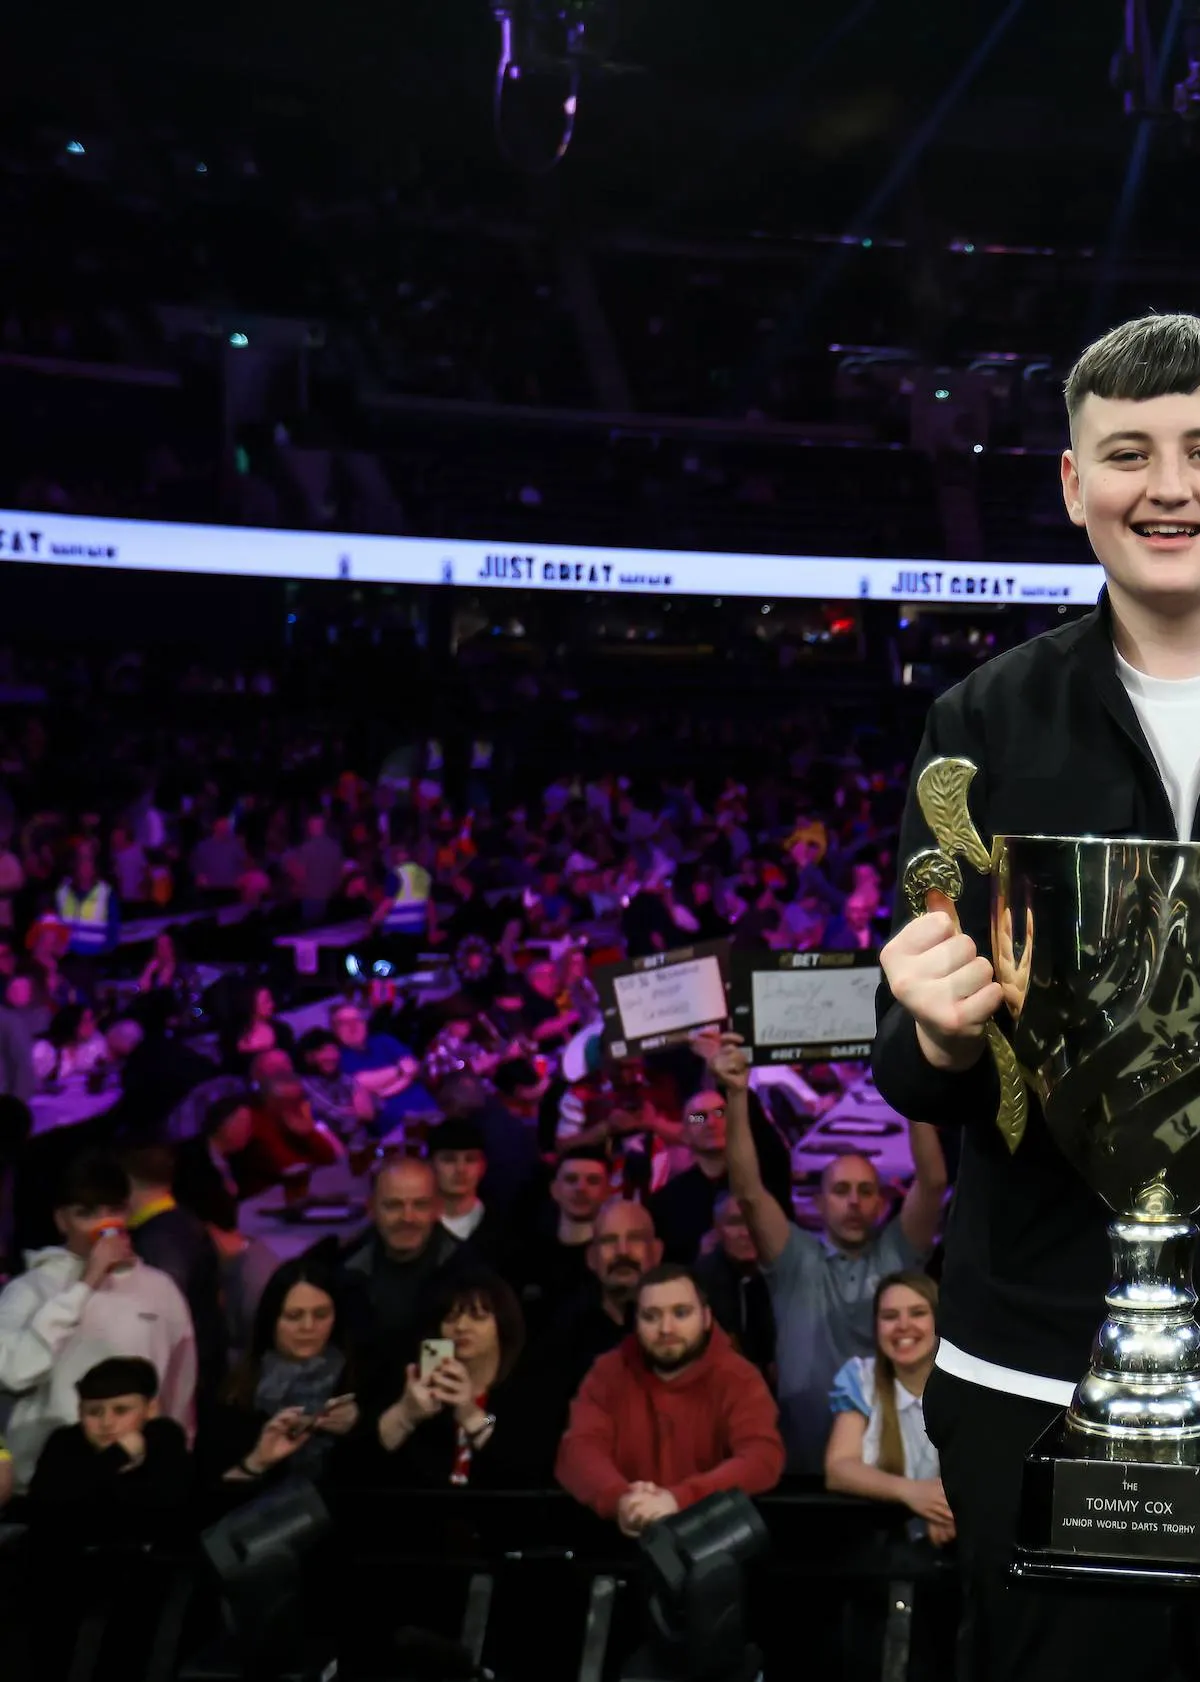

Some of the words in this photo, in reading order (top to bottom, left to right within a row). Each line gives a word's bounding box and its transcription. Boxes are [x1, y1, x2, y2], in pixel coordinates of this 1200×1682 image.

[478, 555, 534, 579] JUST
[543, 562, 612, 582] GREAT
[892, 572, 943, 593] JUST
[951, 576, 1015, 595] GREAT
[771, 1044, 871, 1060] #BETDARTS
[1122, 1481, 1138, 1491] THE
[1086, 1497, 1139, 1512] TOMMY
[1144, 1501, 1173, 1514] COX
[1062, 1518, 1092, 1528] JUNIOR
[1097, 1519, 1127, 1530] WORLD
[1132, 1521, 1158, 1532] DARTS
[1162, 1523, 1196, 1534] TROPHY
